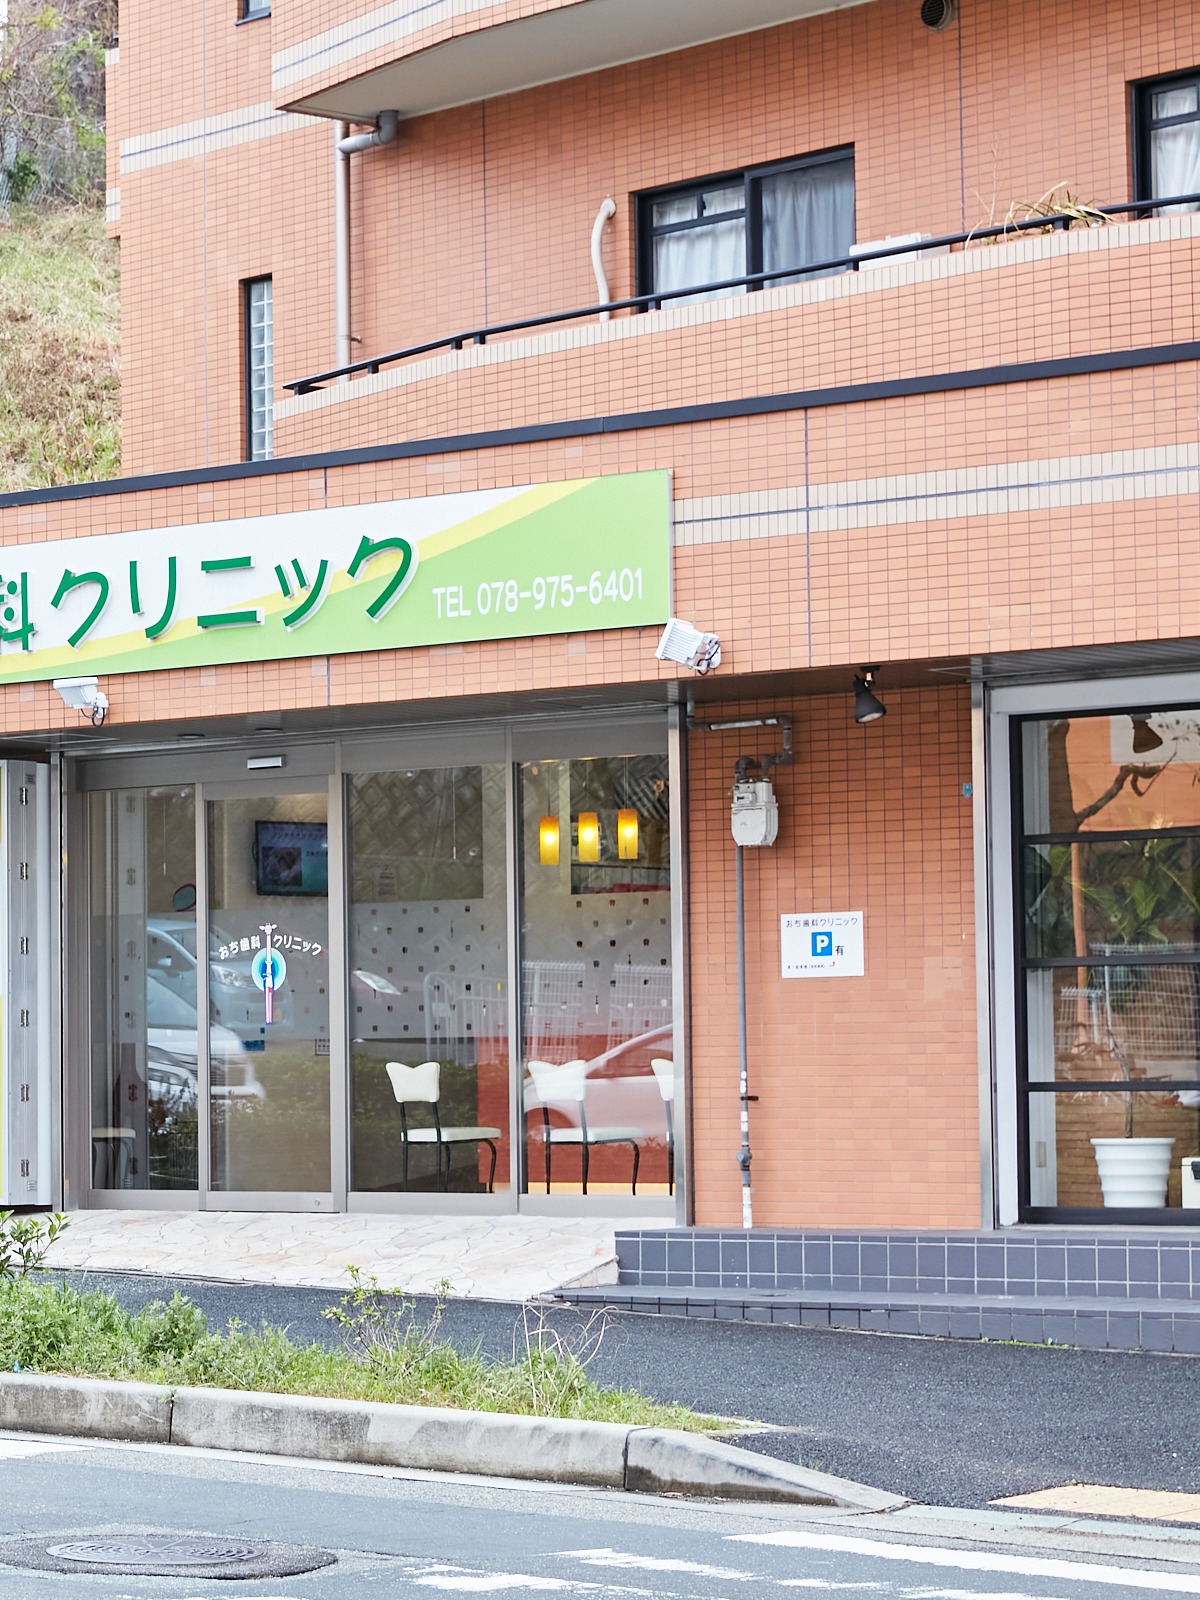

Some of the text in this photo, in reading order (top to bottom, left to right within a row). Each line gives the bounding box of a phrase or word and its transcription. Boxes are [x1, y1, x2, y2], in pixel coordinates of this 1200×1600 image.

[432, 567, 643, 619] TEL 078-975-6401
[786, 917, 858, 928] おち歯科クリニック
[219, 934, 322, 960] おち歯科 クリニック
[816, 935, 829, 954] P
